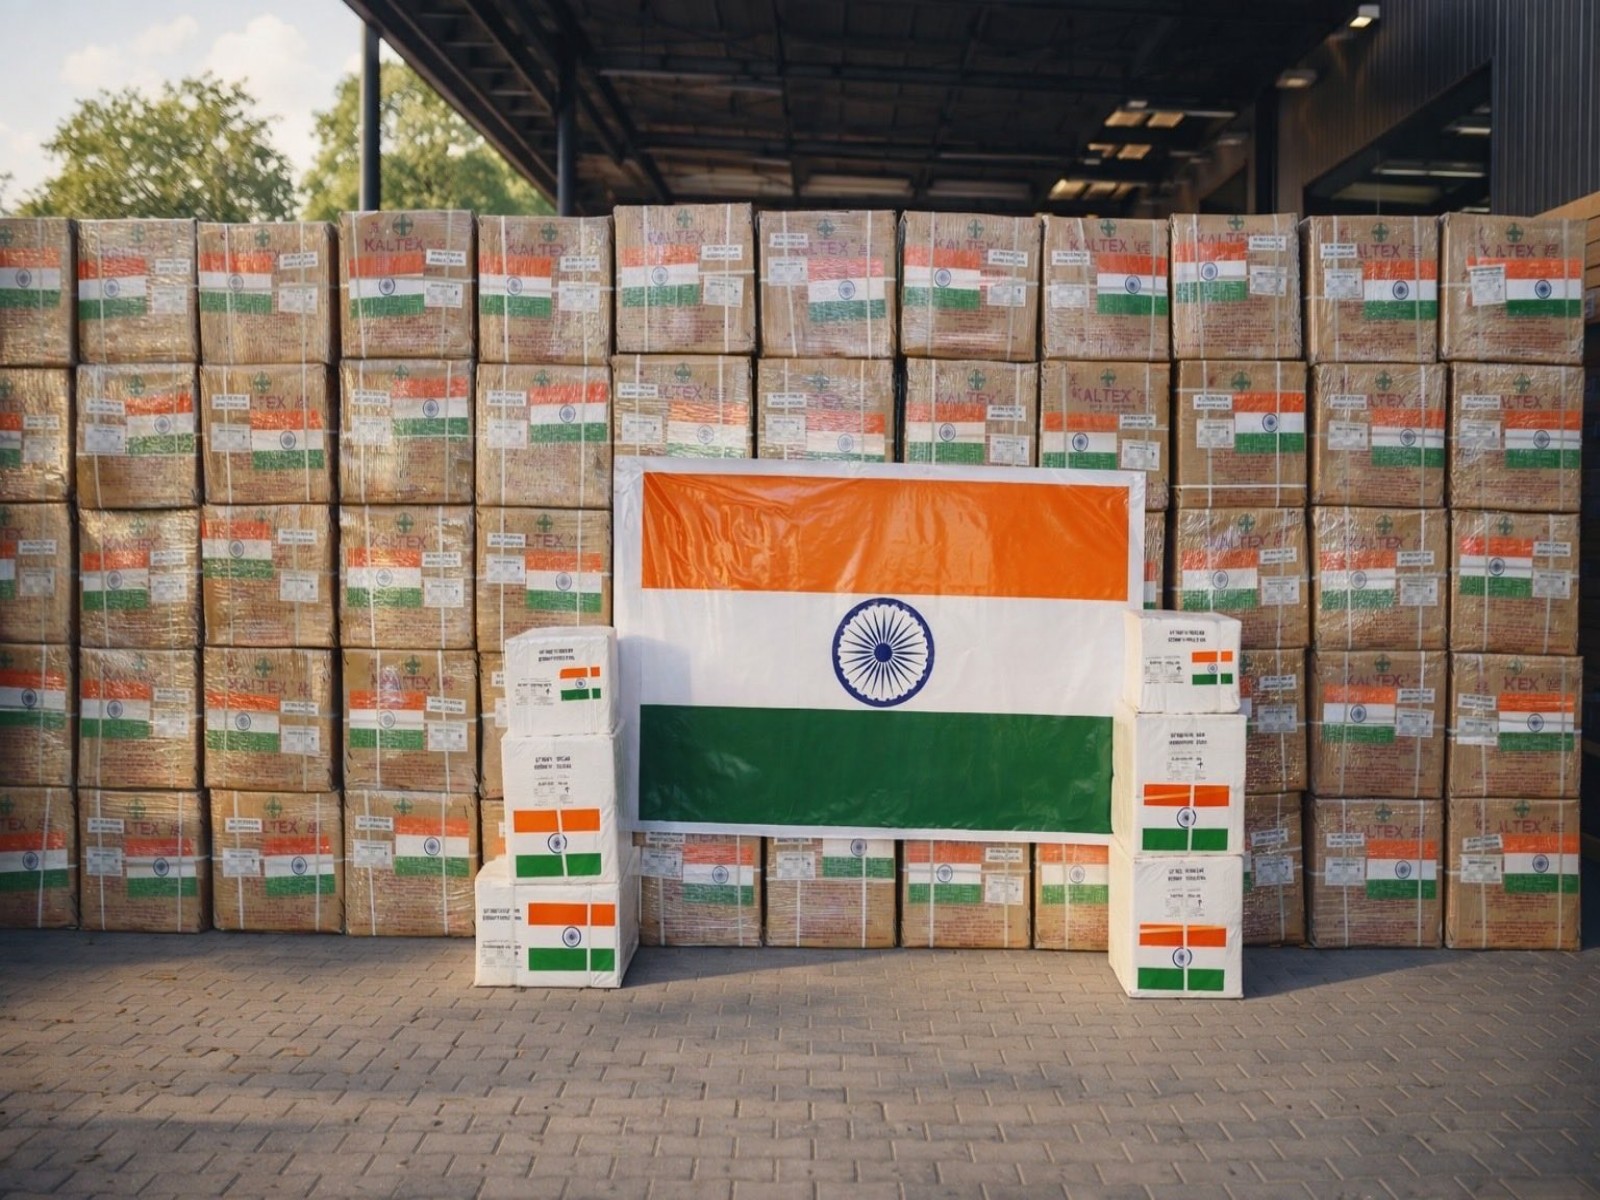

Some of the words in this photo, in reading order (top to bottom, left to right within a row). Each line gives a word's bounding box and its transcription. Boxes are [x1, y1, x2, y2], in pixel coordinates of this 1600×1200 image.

[365, 238, 425, 252] KALTEX
[1070, 239, 1128, 254] KALTEX
[1071, 389, 1132, 403] KALTEX
